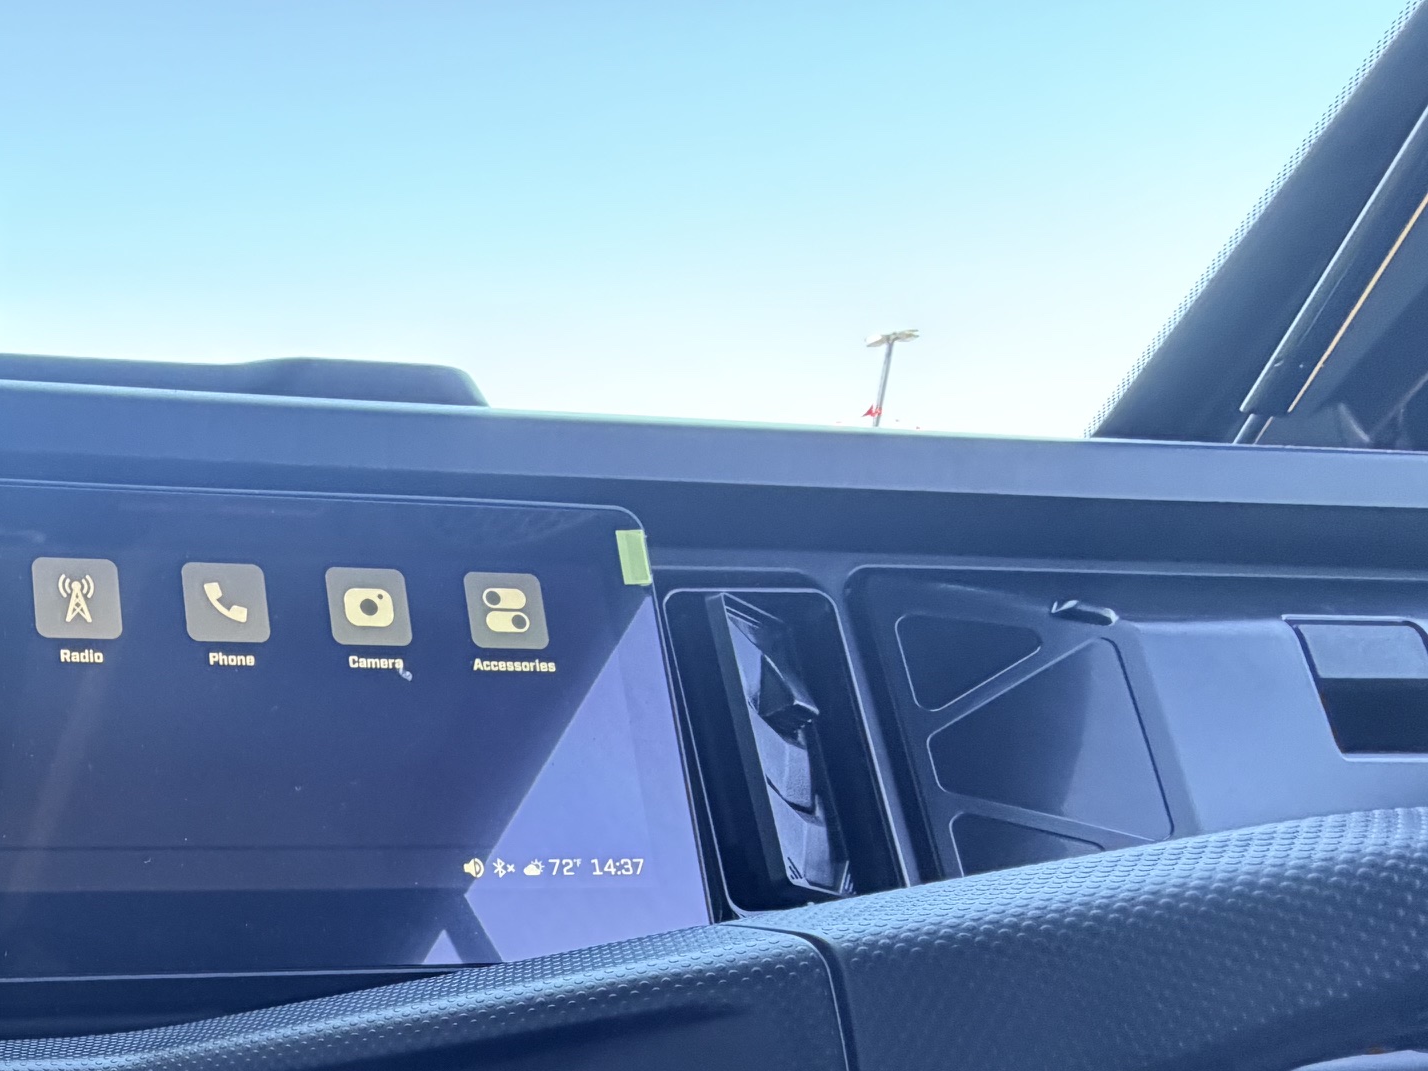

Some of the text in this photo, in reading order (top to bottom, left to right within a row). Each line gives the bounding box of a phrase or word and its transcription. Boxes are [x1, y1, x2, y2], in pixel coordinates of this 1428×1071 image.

[60, 649, 104, 664] Radio
[208, 652, 256, 667] Phone
[348, 656, 404, 670] Camera
[473, 658, 557, 674] Accessories
[591, 858, 644, 876] 14:37
